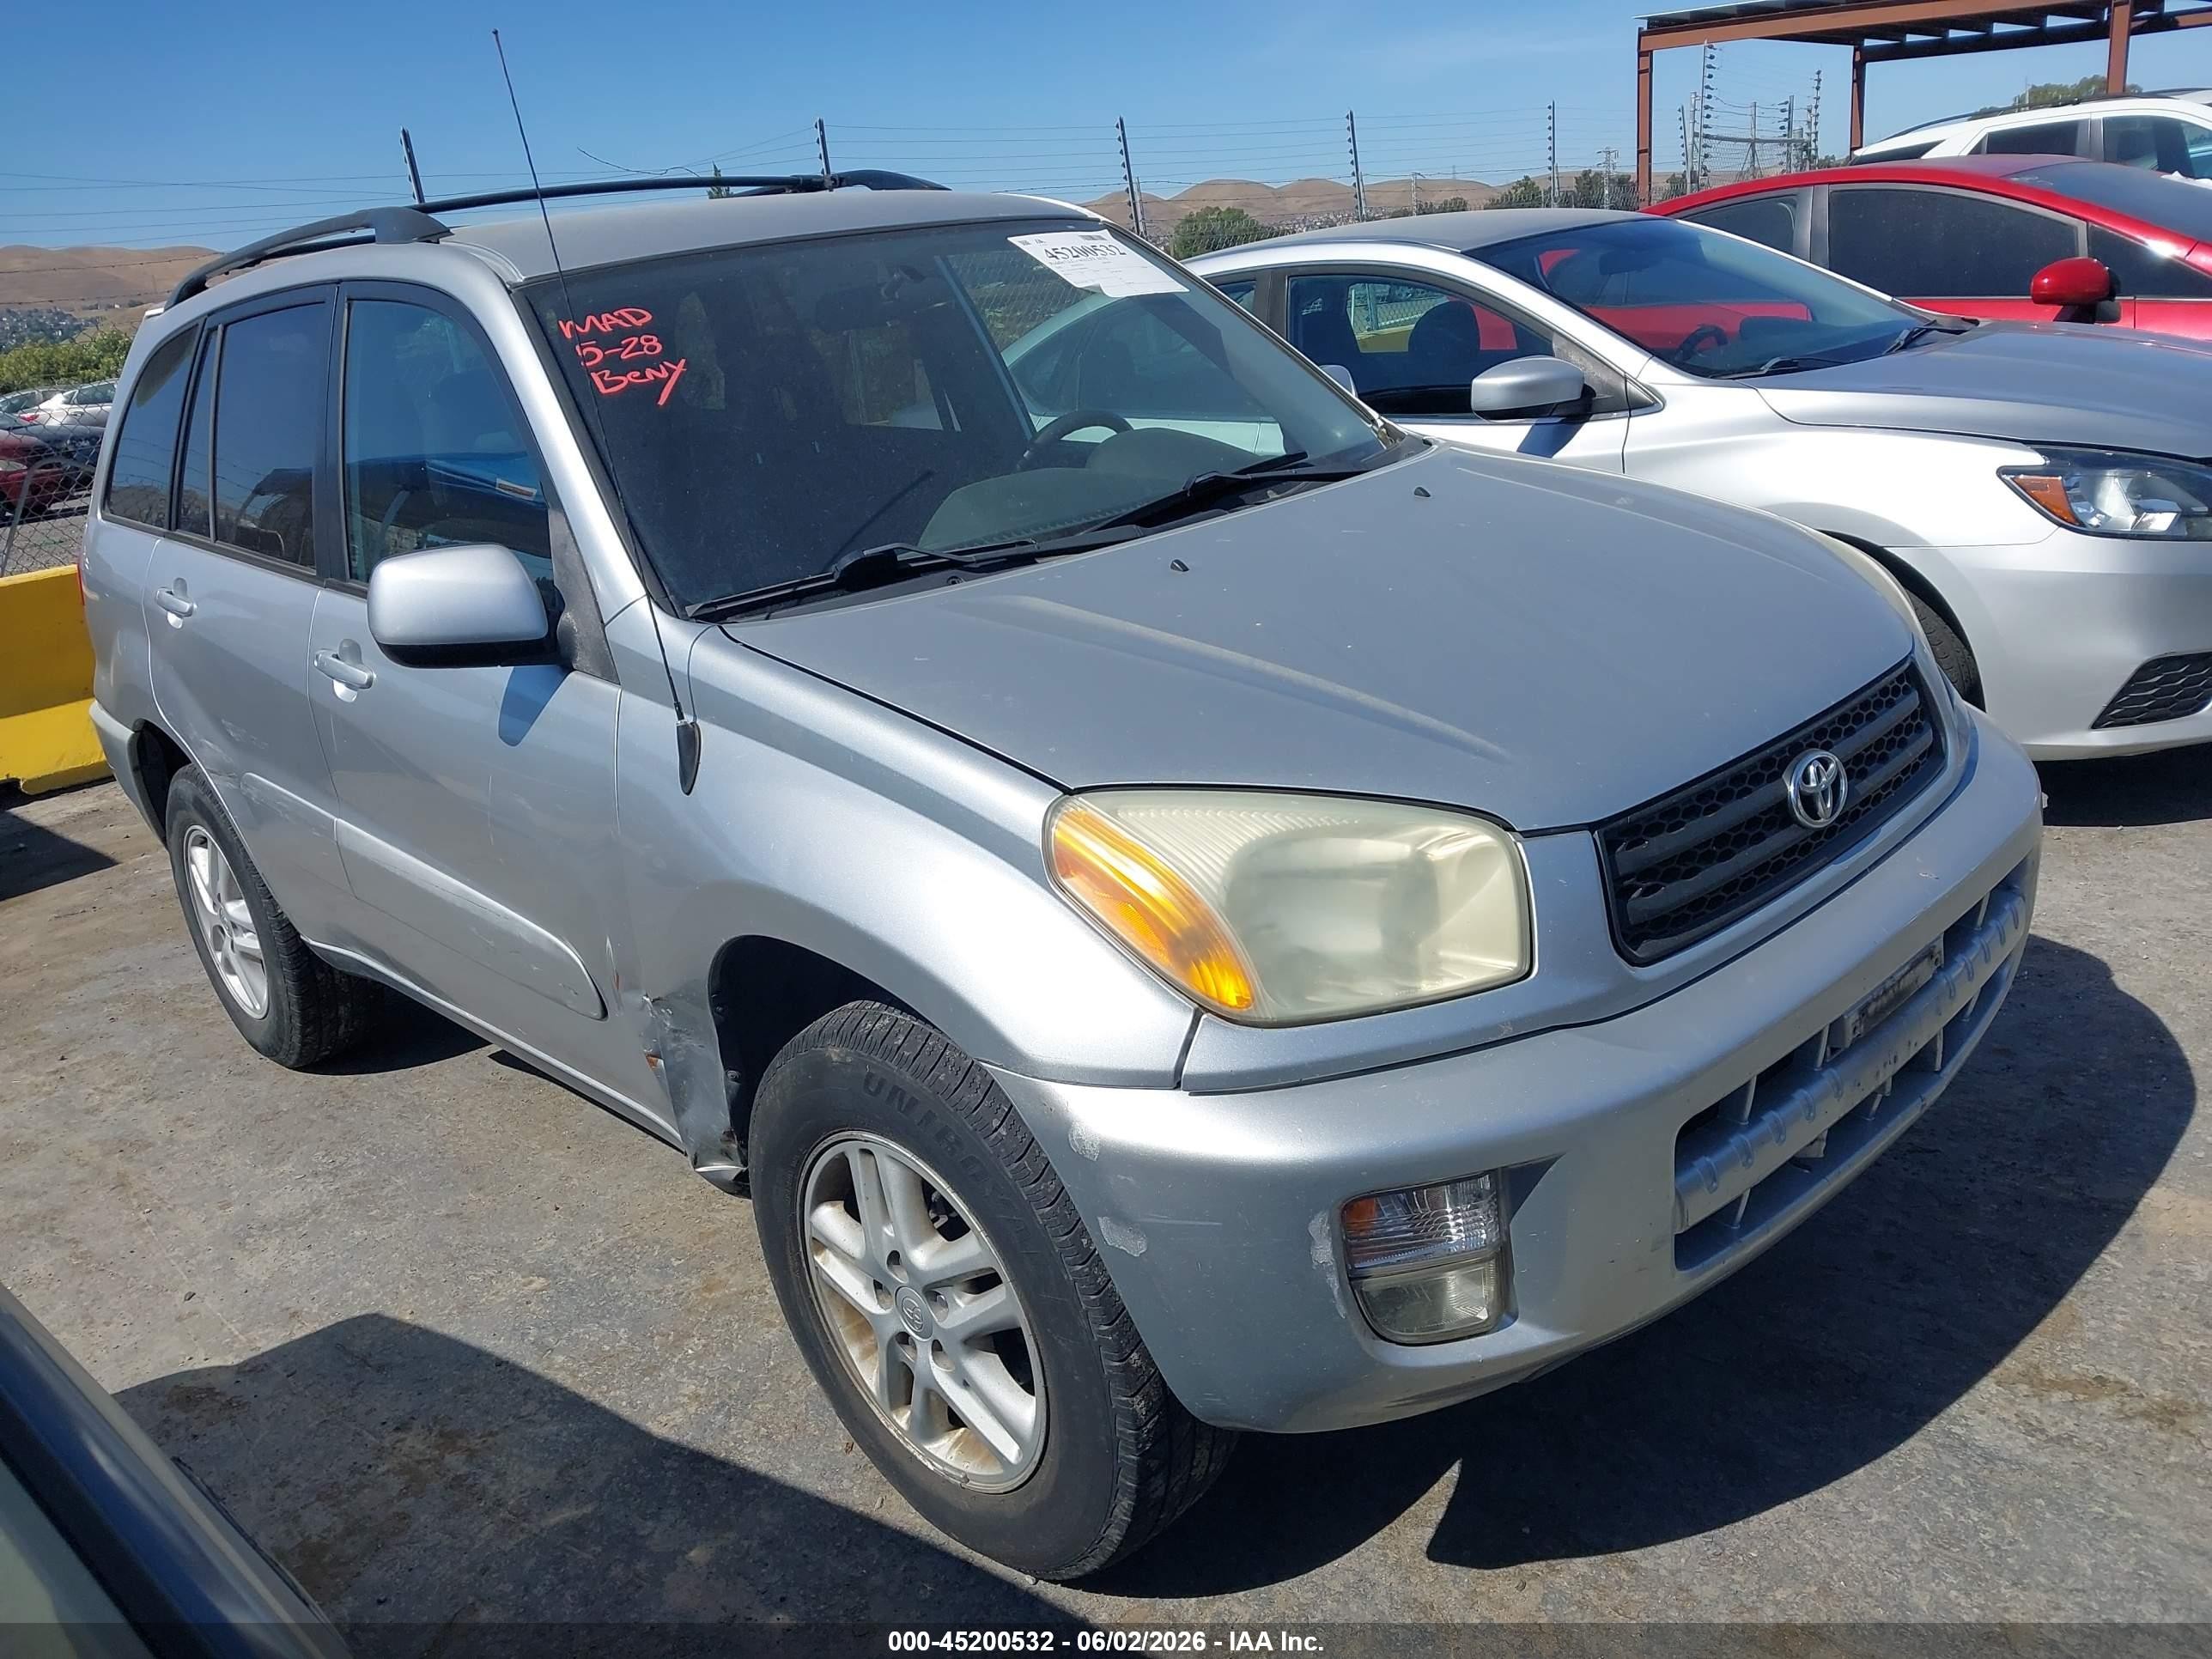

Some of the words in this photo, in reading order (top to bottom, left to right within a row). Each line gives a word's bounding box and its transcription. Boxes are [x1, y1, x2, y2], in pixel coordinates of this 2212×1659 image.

[1043, 245, 1127, 260] 45200532
[558, 308, 653, 338] MAD
[576, 335, 663, 367] 5-28
